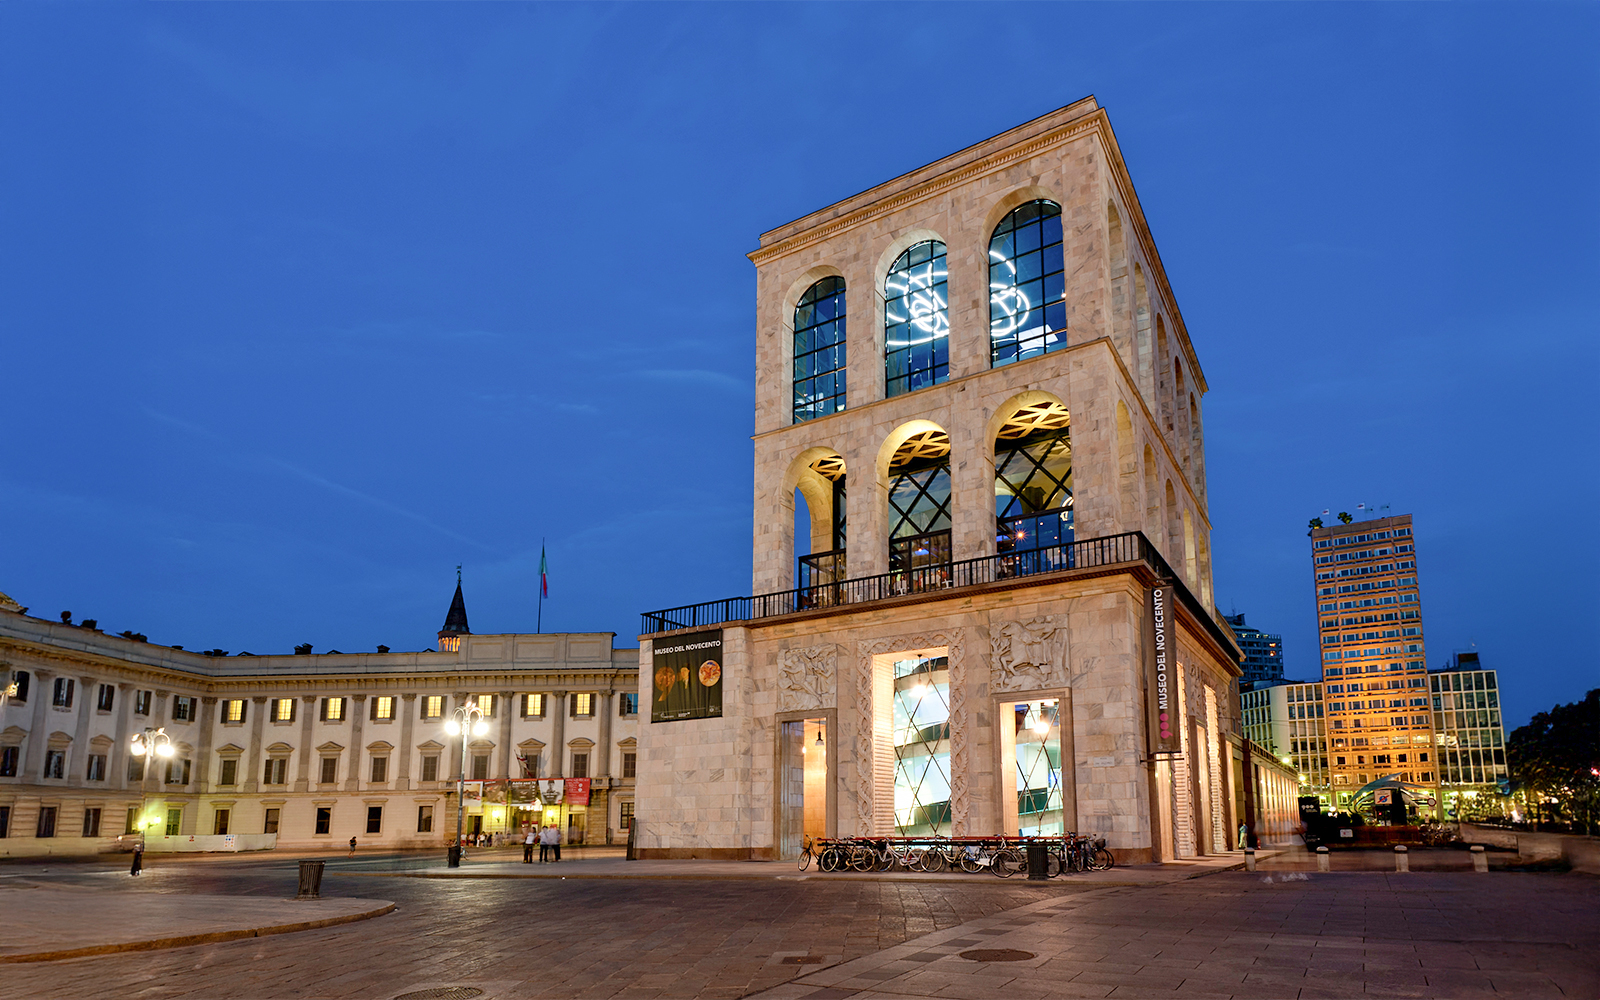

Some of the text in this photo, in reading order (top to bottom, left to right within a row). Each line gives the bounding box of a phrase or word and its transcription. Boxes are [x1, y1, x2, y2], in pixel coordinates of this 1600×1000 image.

[655, 647, 674, 655] MUSEO
[686, 640, 721, 651] NOVECENTO
[1154, 589, 1168, 709] MUSEO DEL NOVECENTO
